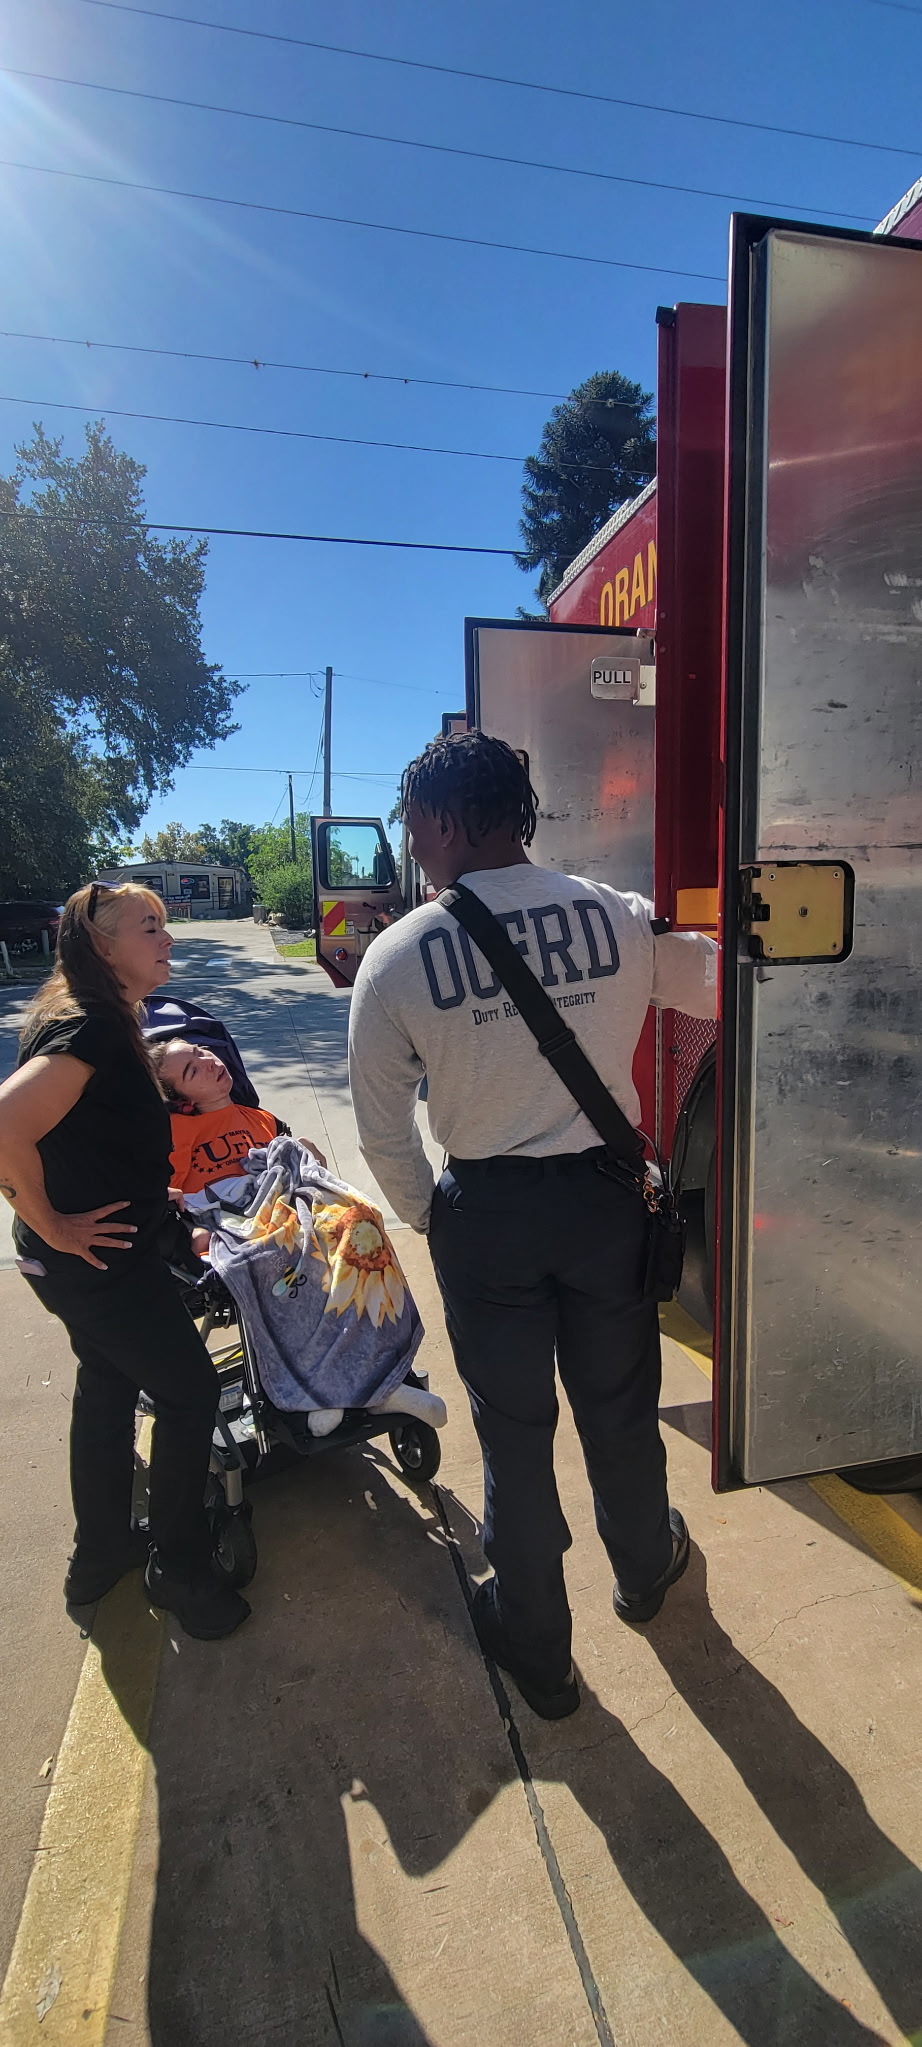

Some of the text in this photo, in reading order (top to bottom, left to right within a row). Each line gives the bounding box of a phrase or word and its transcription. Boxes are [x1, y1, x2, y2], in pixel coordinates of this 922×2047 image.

[593, 670, 631, 684] PULL
[551, 992, 596, 1009] TEGRITY
[198, 1131, 269, 1162] Urib
